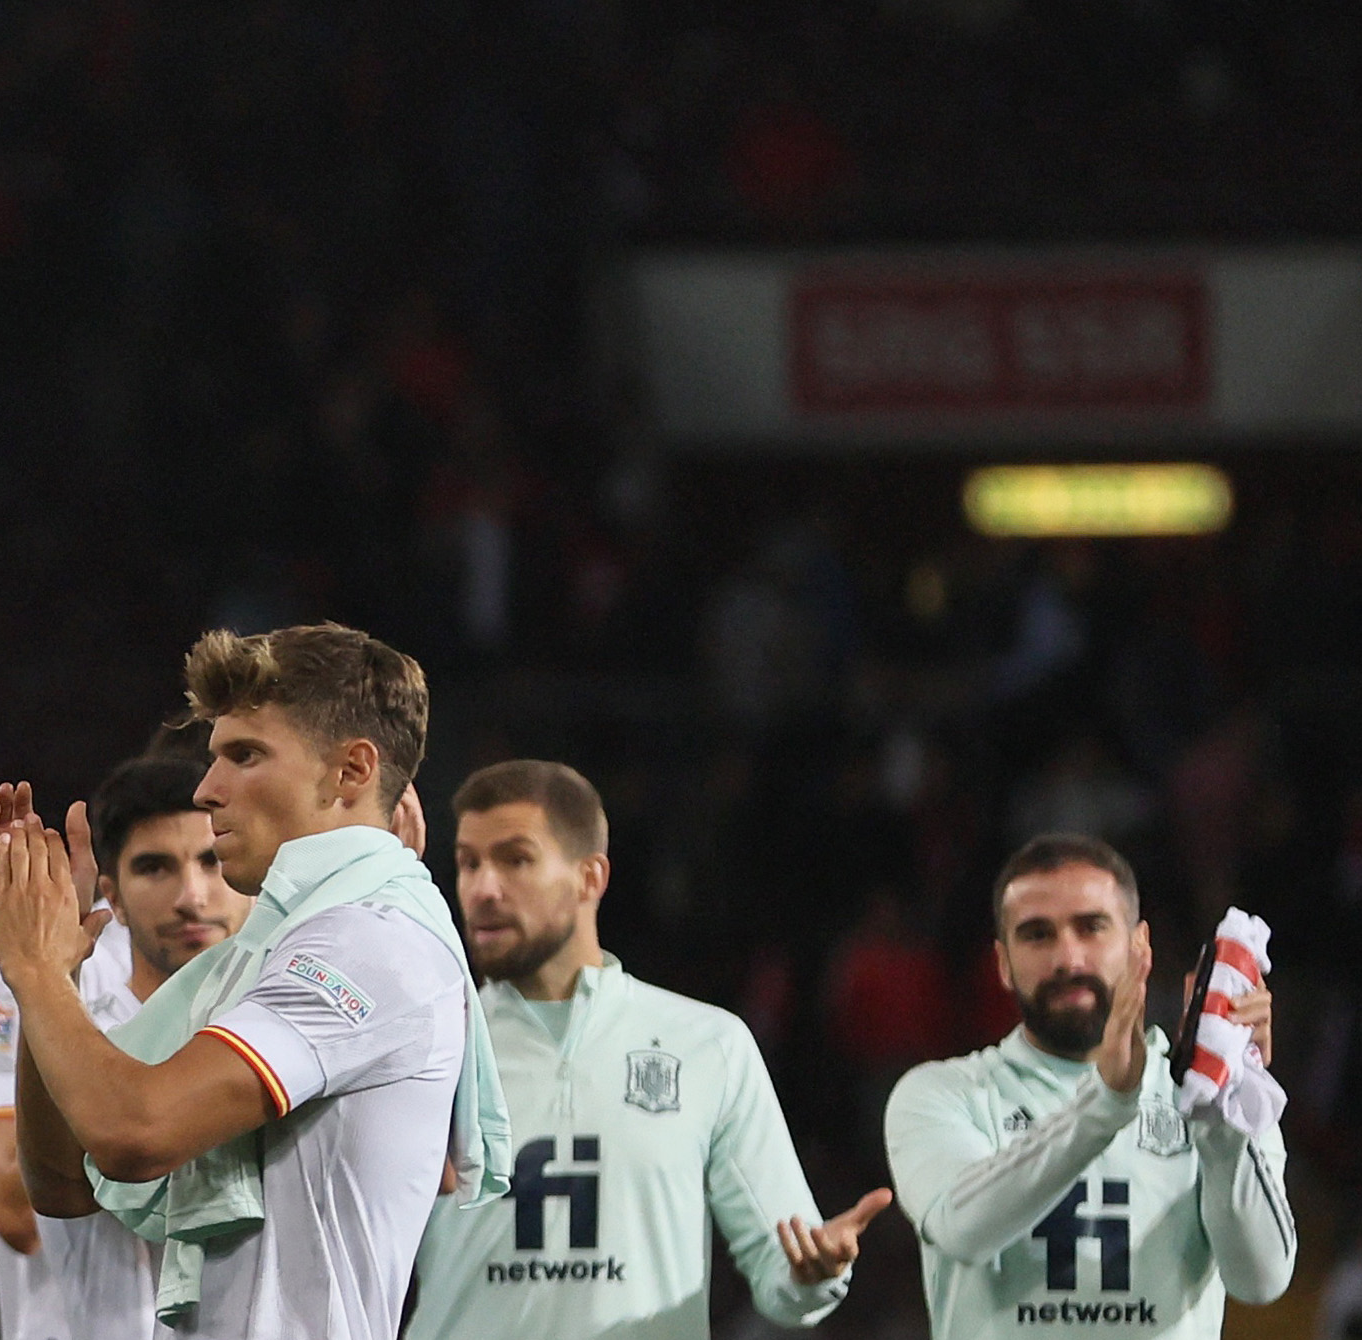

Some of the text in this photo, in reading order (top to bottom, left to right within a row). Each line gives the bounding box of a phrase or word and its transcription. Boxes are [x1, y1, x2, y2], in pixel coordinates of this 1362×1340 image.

[288, 960, 368, 1018] FOUNDATION
[512, 1134, 600, 1250] fi
[487, 1256, 625, 1284] network
[1017, 1298, 1158, 1325] network
